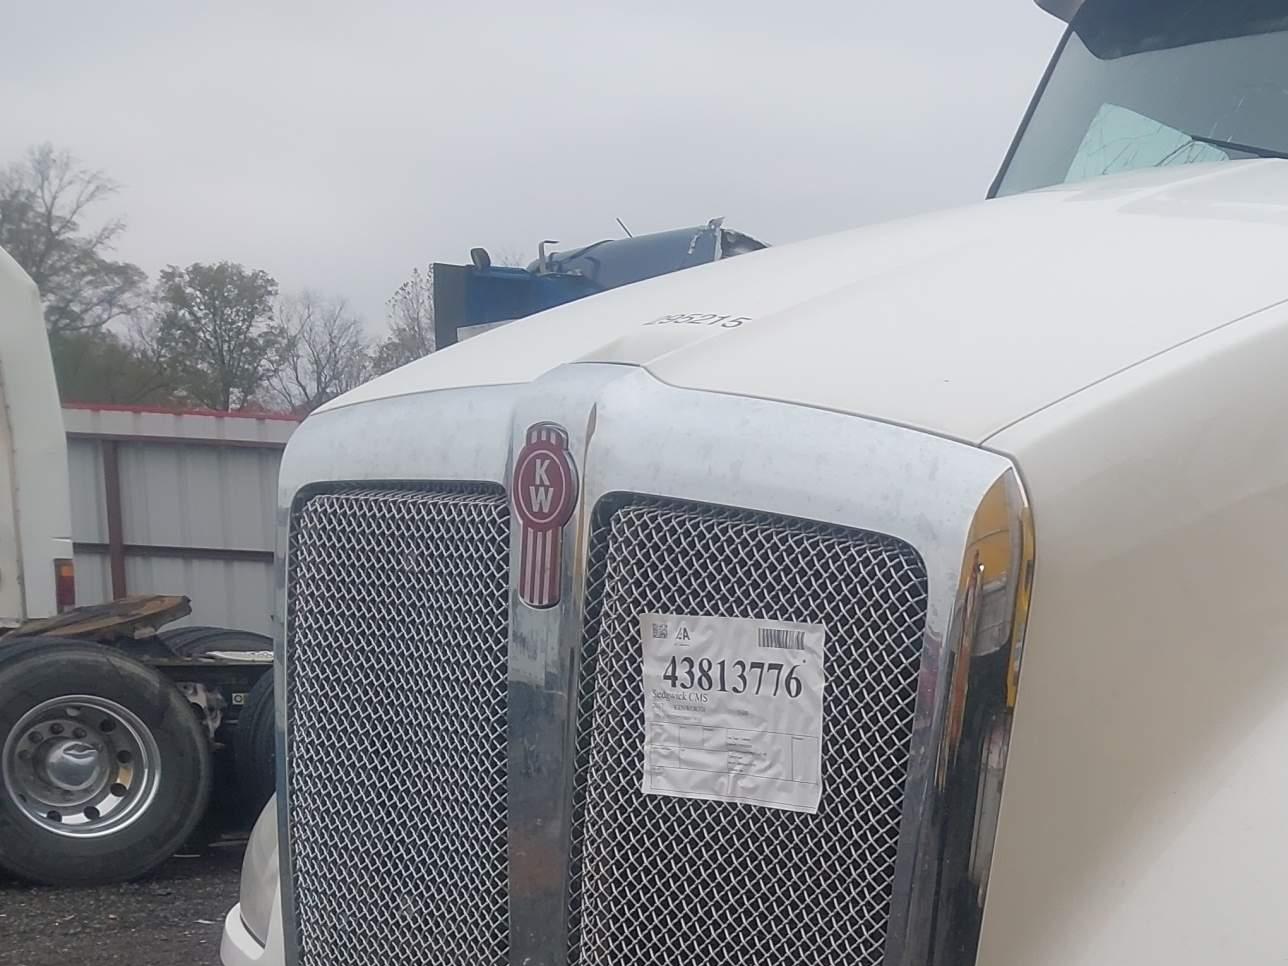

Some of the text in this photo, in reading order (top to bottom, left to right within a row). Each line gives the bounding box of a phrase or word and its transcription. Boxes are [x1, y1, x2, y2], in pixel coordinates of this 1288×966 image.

[535, 459, 550, 486] K
[529, 486, 554, 513] W
[663, 656, 802, 698] 43813776
[688, 692, 708, 703] CMS
